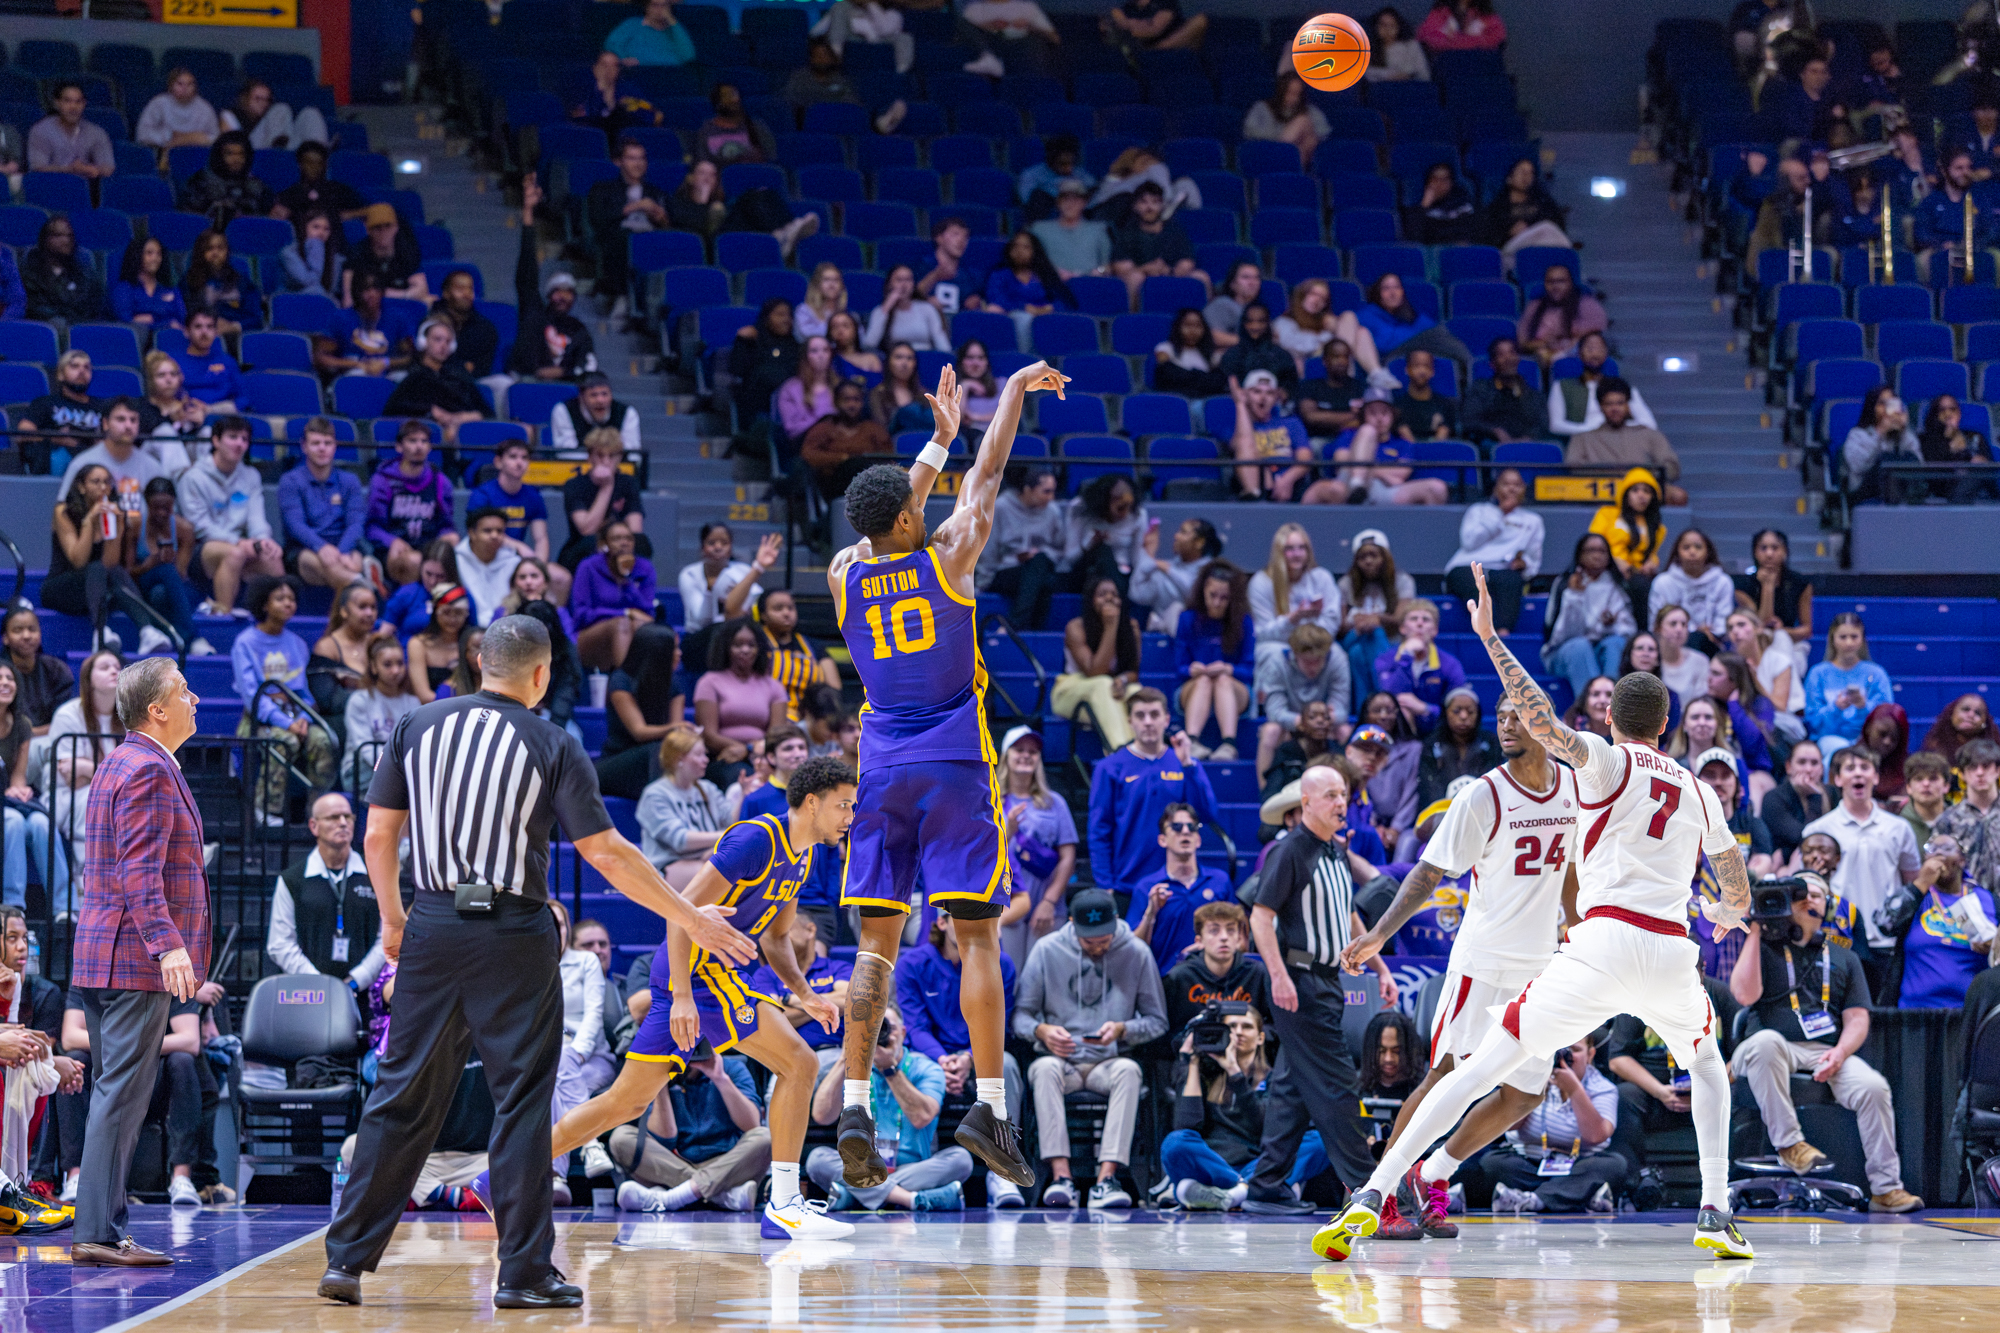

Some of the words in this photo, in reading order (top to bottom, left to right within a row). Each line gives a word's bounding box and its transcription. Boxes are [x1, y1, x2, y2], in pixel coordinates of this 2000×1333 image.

[861, 568, 920, 599] SUTTON
[865, 596, 936, 660] 10
[1509, 816, 1577, 830] RAZORBACKS
[1646, 776, 1682, 841] 7
[1514, 833, 1566, 876] 24
[762, 878, 802, 902] LSU
[749, 904, 778, 935] 8
[279, 989, 324, 1005] LSU
